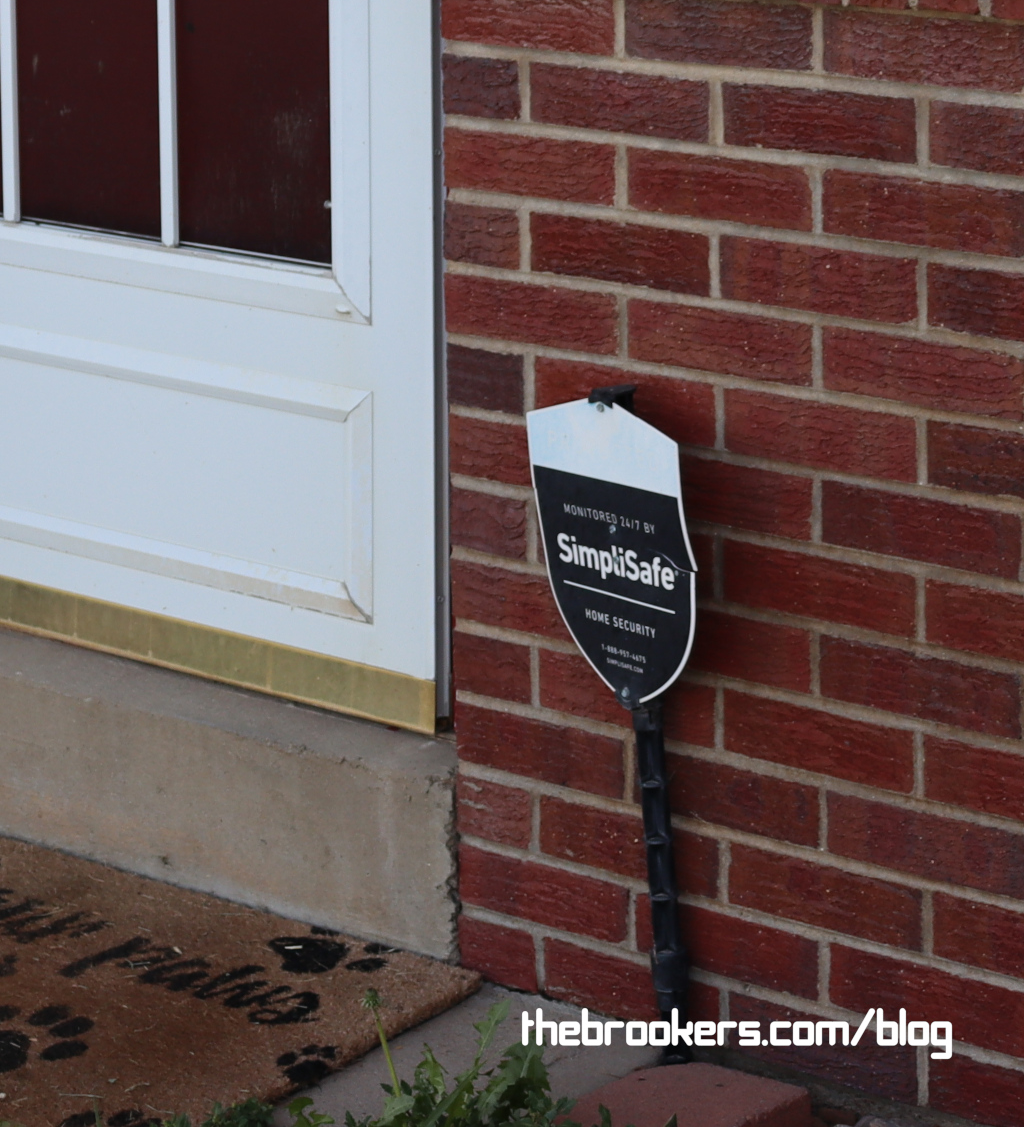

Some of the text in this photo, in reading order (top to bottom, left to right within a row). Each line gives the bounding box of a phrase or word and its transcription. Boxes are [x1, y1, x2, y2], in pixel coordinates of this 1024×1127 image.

[563, 503, 655, 534] MONITORED 24/7 BY
[557, 532, 675, 590] SimpliSafe
[585, 608, 656, 638] HOME SECURITY
